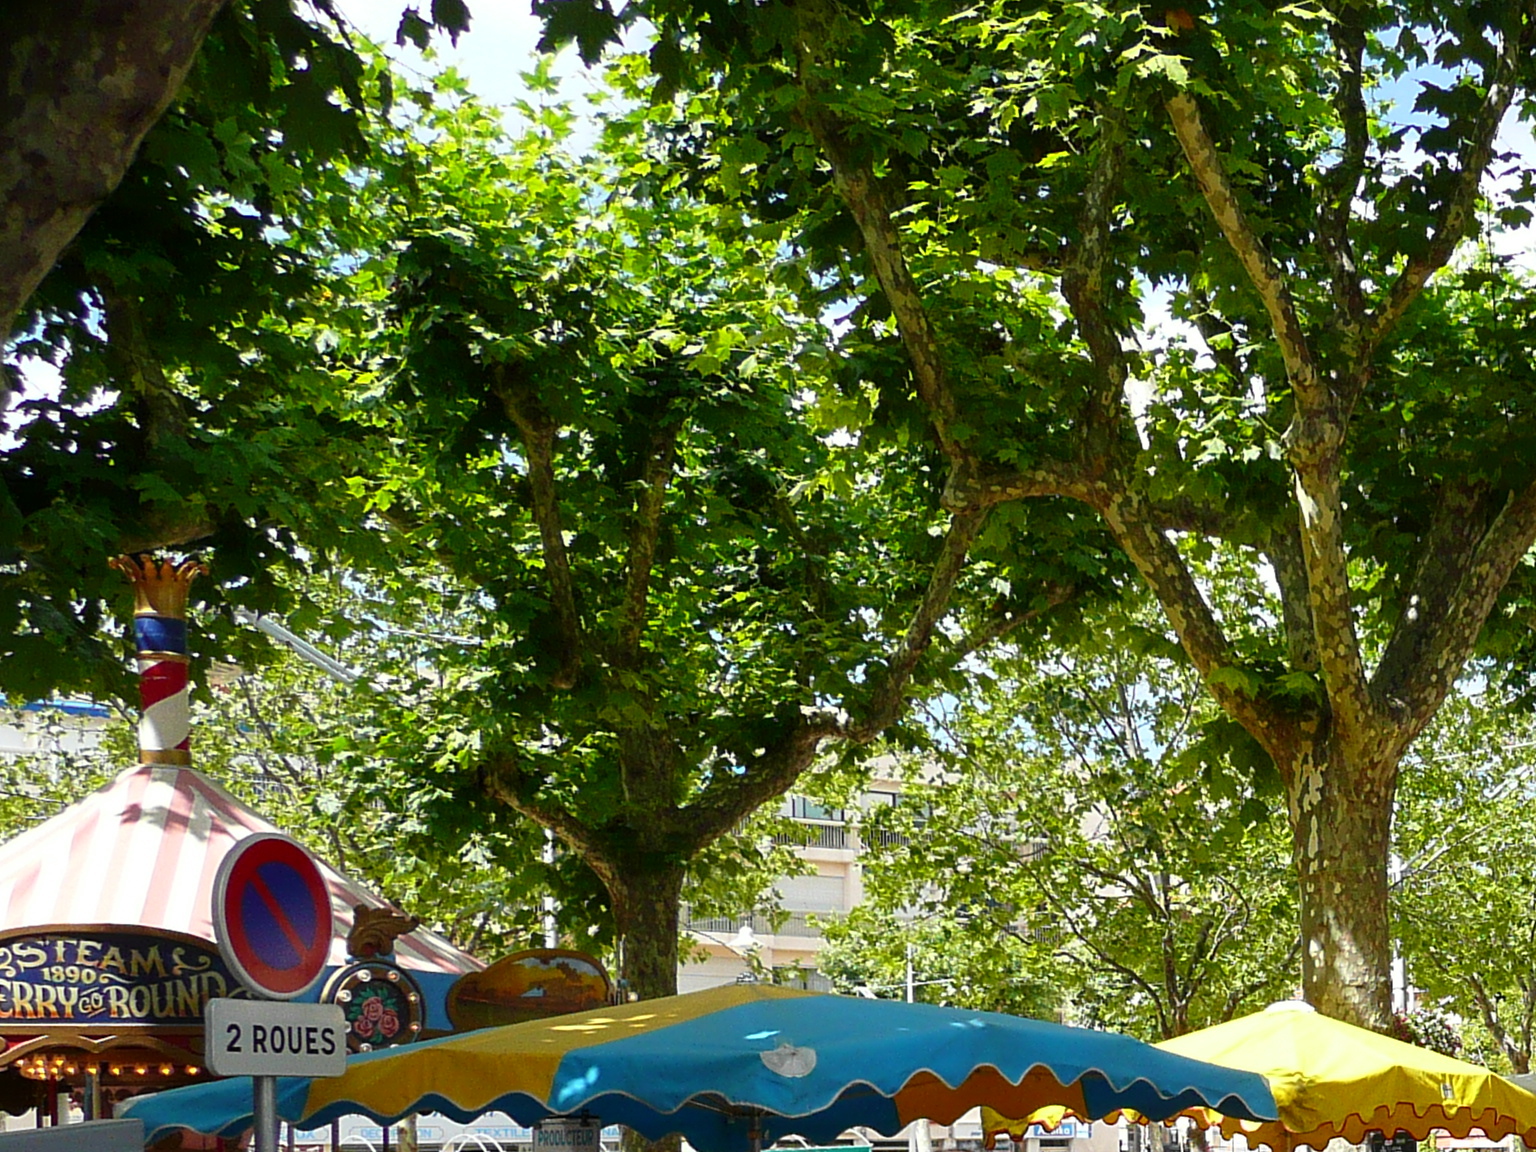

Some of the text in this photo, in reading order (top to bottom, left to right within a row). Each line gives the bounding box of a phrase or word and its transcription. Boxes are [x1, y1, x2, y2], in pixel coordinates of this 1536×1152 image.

[12, 940, 169, 977] STEAM
[41, 965, 97, 984] 1890
[79, 992, 104, 1013] GO
[103, 971, 227, 1018] ROUND
[226, 1024, 336, 1055] 2 ROUES
[537, 1129, 594, 1147] PRODUCTEUR
